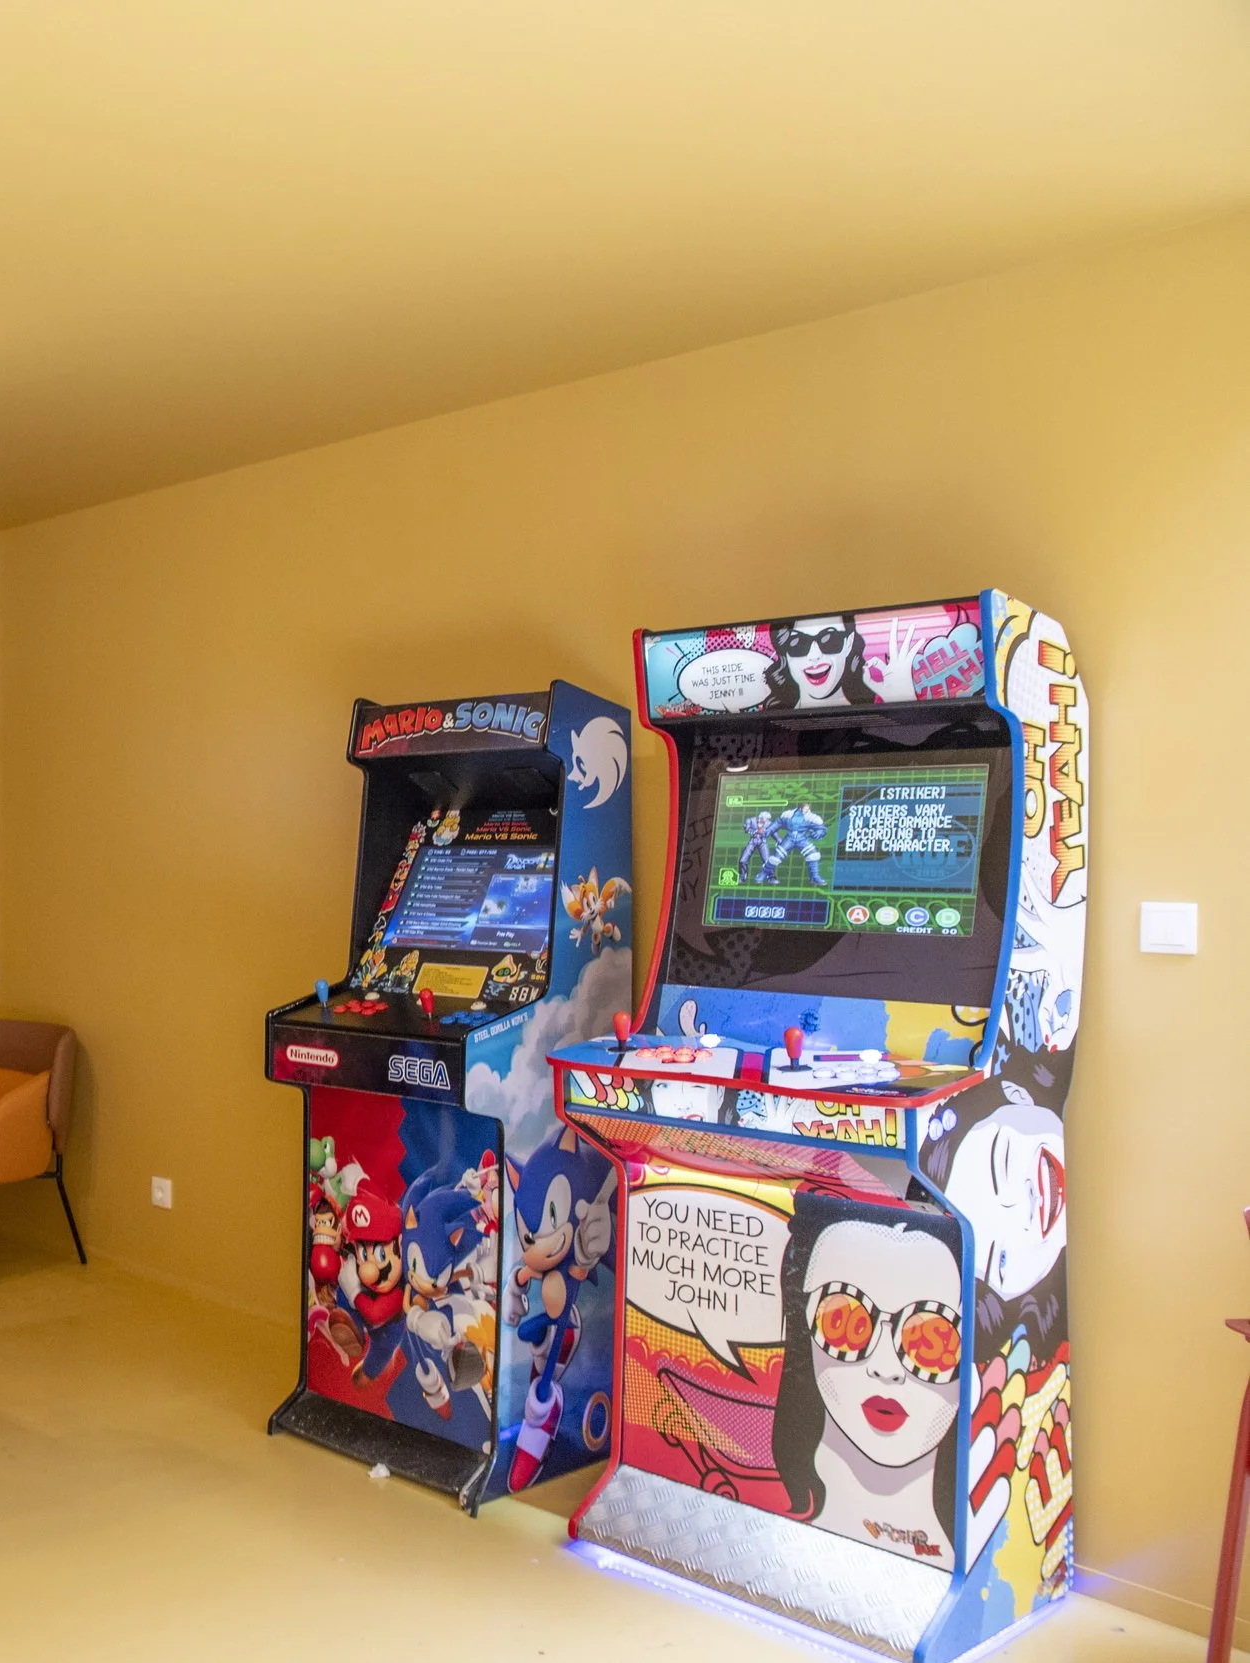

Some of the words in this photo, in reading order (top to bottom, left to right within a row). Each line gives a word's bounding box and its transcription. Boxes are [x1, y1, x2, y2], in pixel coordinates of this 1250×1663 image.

[702, 666, 720, 675] THIS
[722, 663, 744, 673] RIDE
[912, 640, 969, 685] HELL
[692, 678, 709, 688] WAS
[711, 676, 731, 687] JUST
[734, 673, 756, 683] FINE
[709, 688, 737, 699] JENNY
[360, 706, 444, 751] MARIO
[442, 712, 455, 730] &
[454, 702, 547, 740] SONIC
[1037, 640, 1087, 905] YEAH!
[880, 785, 947, 800] [STRIKER]
[849, 804, 909, 818] STRIKERS
[915, 803, 946, 817] VARY
[849, 817, 864, 829] IN
[869, 815, 953, 829] PERFORMANCE
[464, 832, 492, 841] Mario
[494, 833, 509, 841] VS
[510, 832, 539, 841] Sonic
[847, 828, 914, 841] ACCORDING
[920, 827, 937, 840] TO
[845, 839, 876, 852] EACH
[881, 838, 954, 852] CHARACTER.
[850, 908, 866, 921] A
[880, 909, 895, 921] B
[910, 910, 926, 921] C
[941, 911, 956, 923] D
[896, 926, 933, 935] CREDIT
[473, 1029, 491, 1044] STEEL
[490, 1020, 511, 1037] GORILLA
[289, 1047, 335, 1065] Nintendo
[388, 1054, 451, 1090] SEGA
[643, 1195, 690, 1224] YOU
[696, 1206, 764, 1238] NEED
[637, 1220, 662, 1244] TO
[668, 1227, 769, 1267] PRACTICE
[632, 1245, 695, 1280] MUCH
[703, 1261, 776, 1297] MORE
[664, 1279, 728, 1312] JOHN
